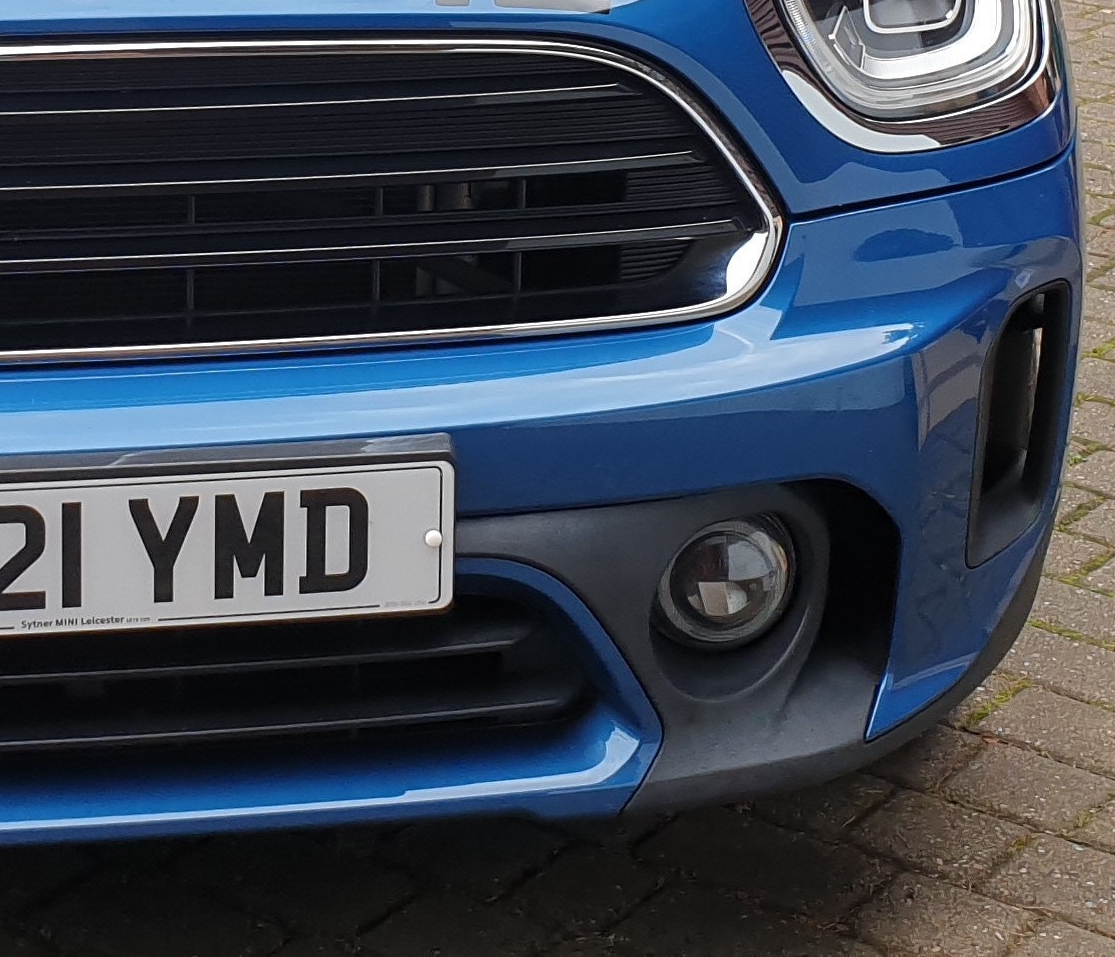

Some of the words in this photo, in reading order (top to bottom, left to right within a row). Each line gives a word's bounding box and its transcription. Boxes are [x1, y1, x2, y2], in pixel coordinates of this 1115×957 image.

[128, 486, 370, 604] YMD
[21, 619, 53, 630] Sytner
[55, 617, 78, 627] MINI
[80, 615, 125, 626] Leicester
